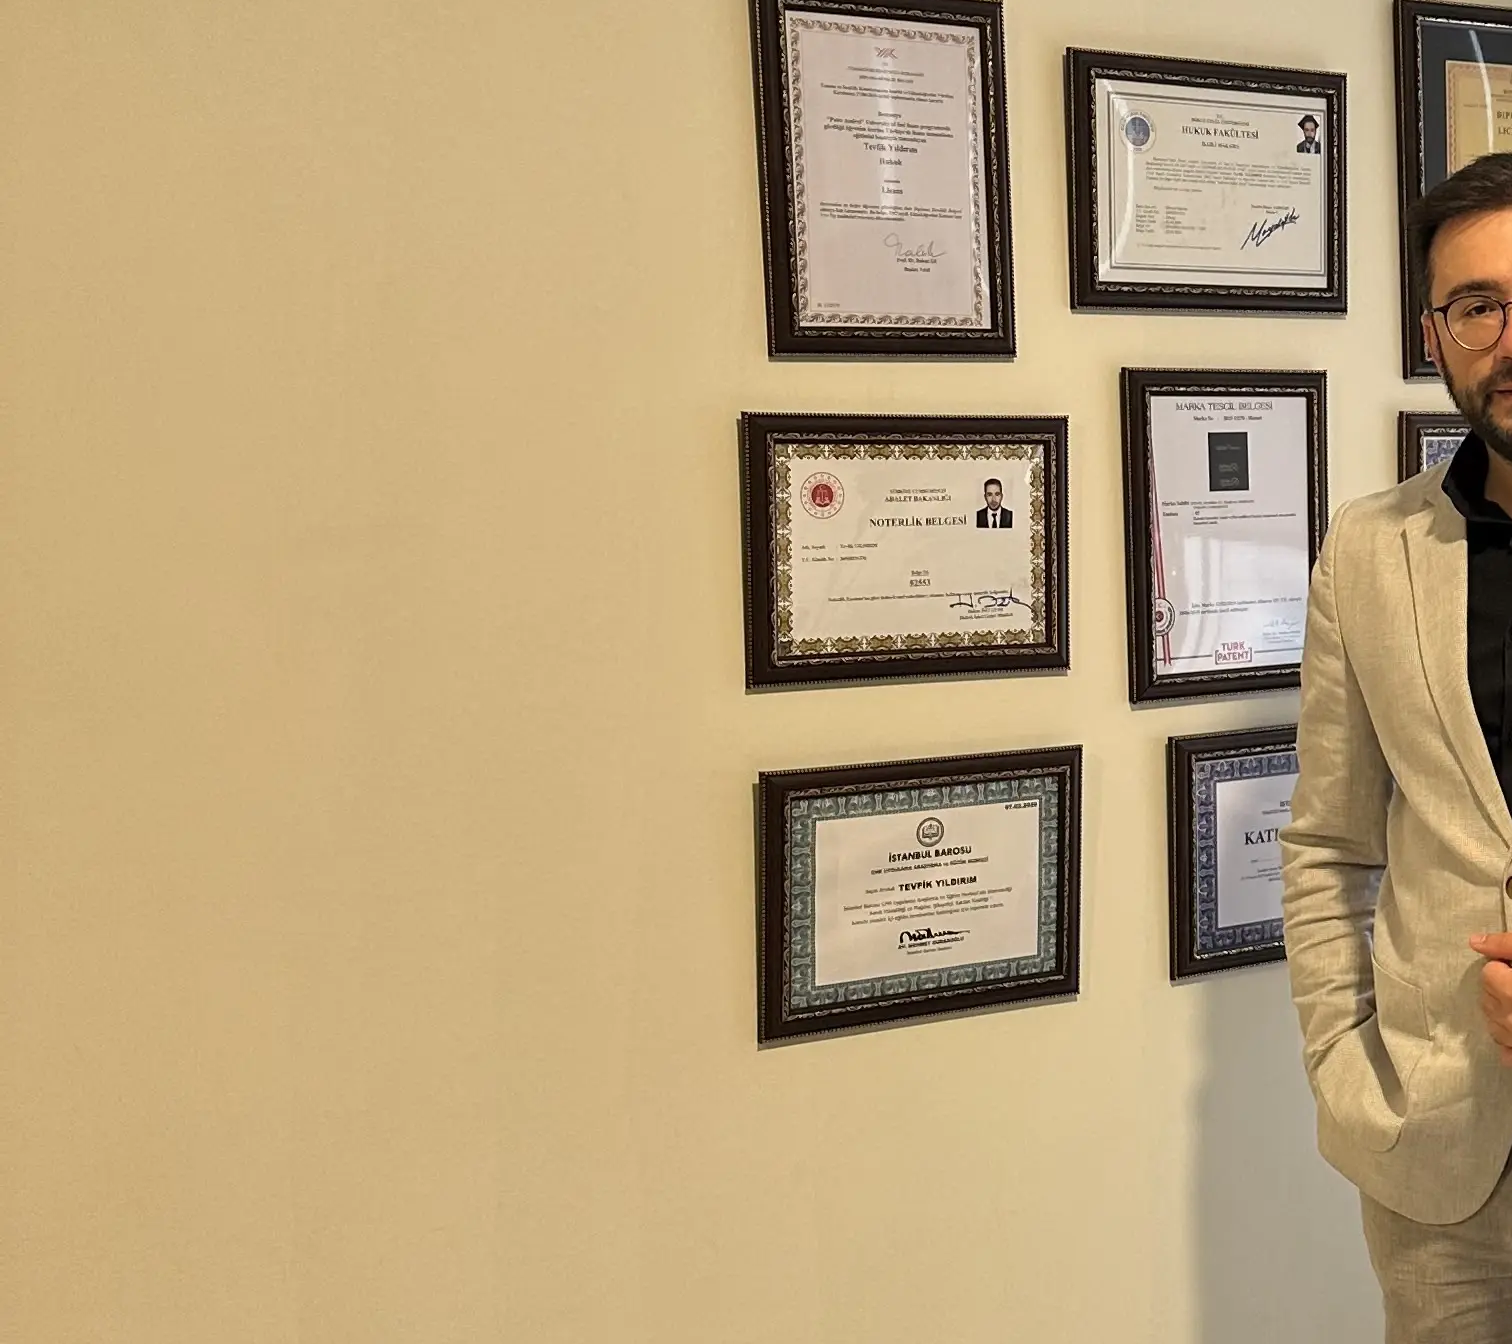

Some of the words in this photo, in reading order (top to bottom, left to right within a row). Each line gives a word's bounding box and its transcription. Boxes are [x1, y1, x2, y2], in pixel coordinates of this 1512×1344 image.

[1182, 125, 1212, 136] HUKUK
[1213, 127, 1259, 139] FAKÜLTESİ
[1175, 402, 1206, 411] MARKA
[869, 516, 922, 527] NOTERLİK
[925, 514, 967, 526] BELGESİ
[1244, 828, 1279, 845] KATI
[888, 850, 932, 863] İSTANBUL
[934, 845, 972, 858] BAROSU
[898, 879, 933, 892] TEVFİK
[935, 875, 977, 888] YILDIRIM
